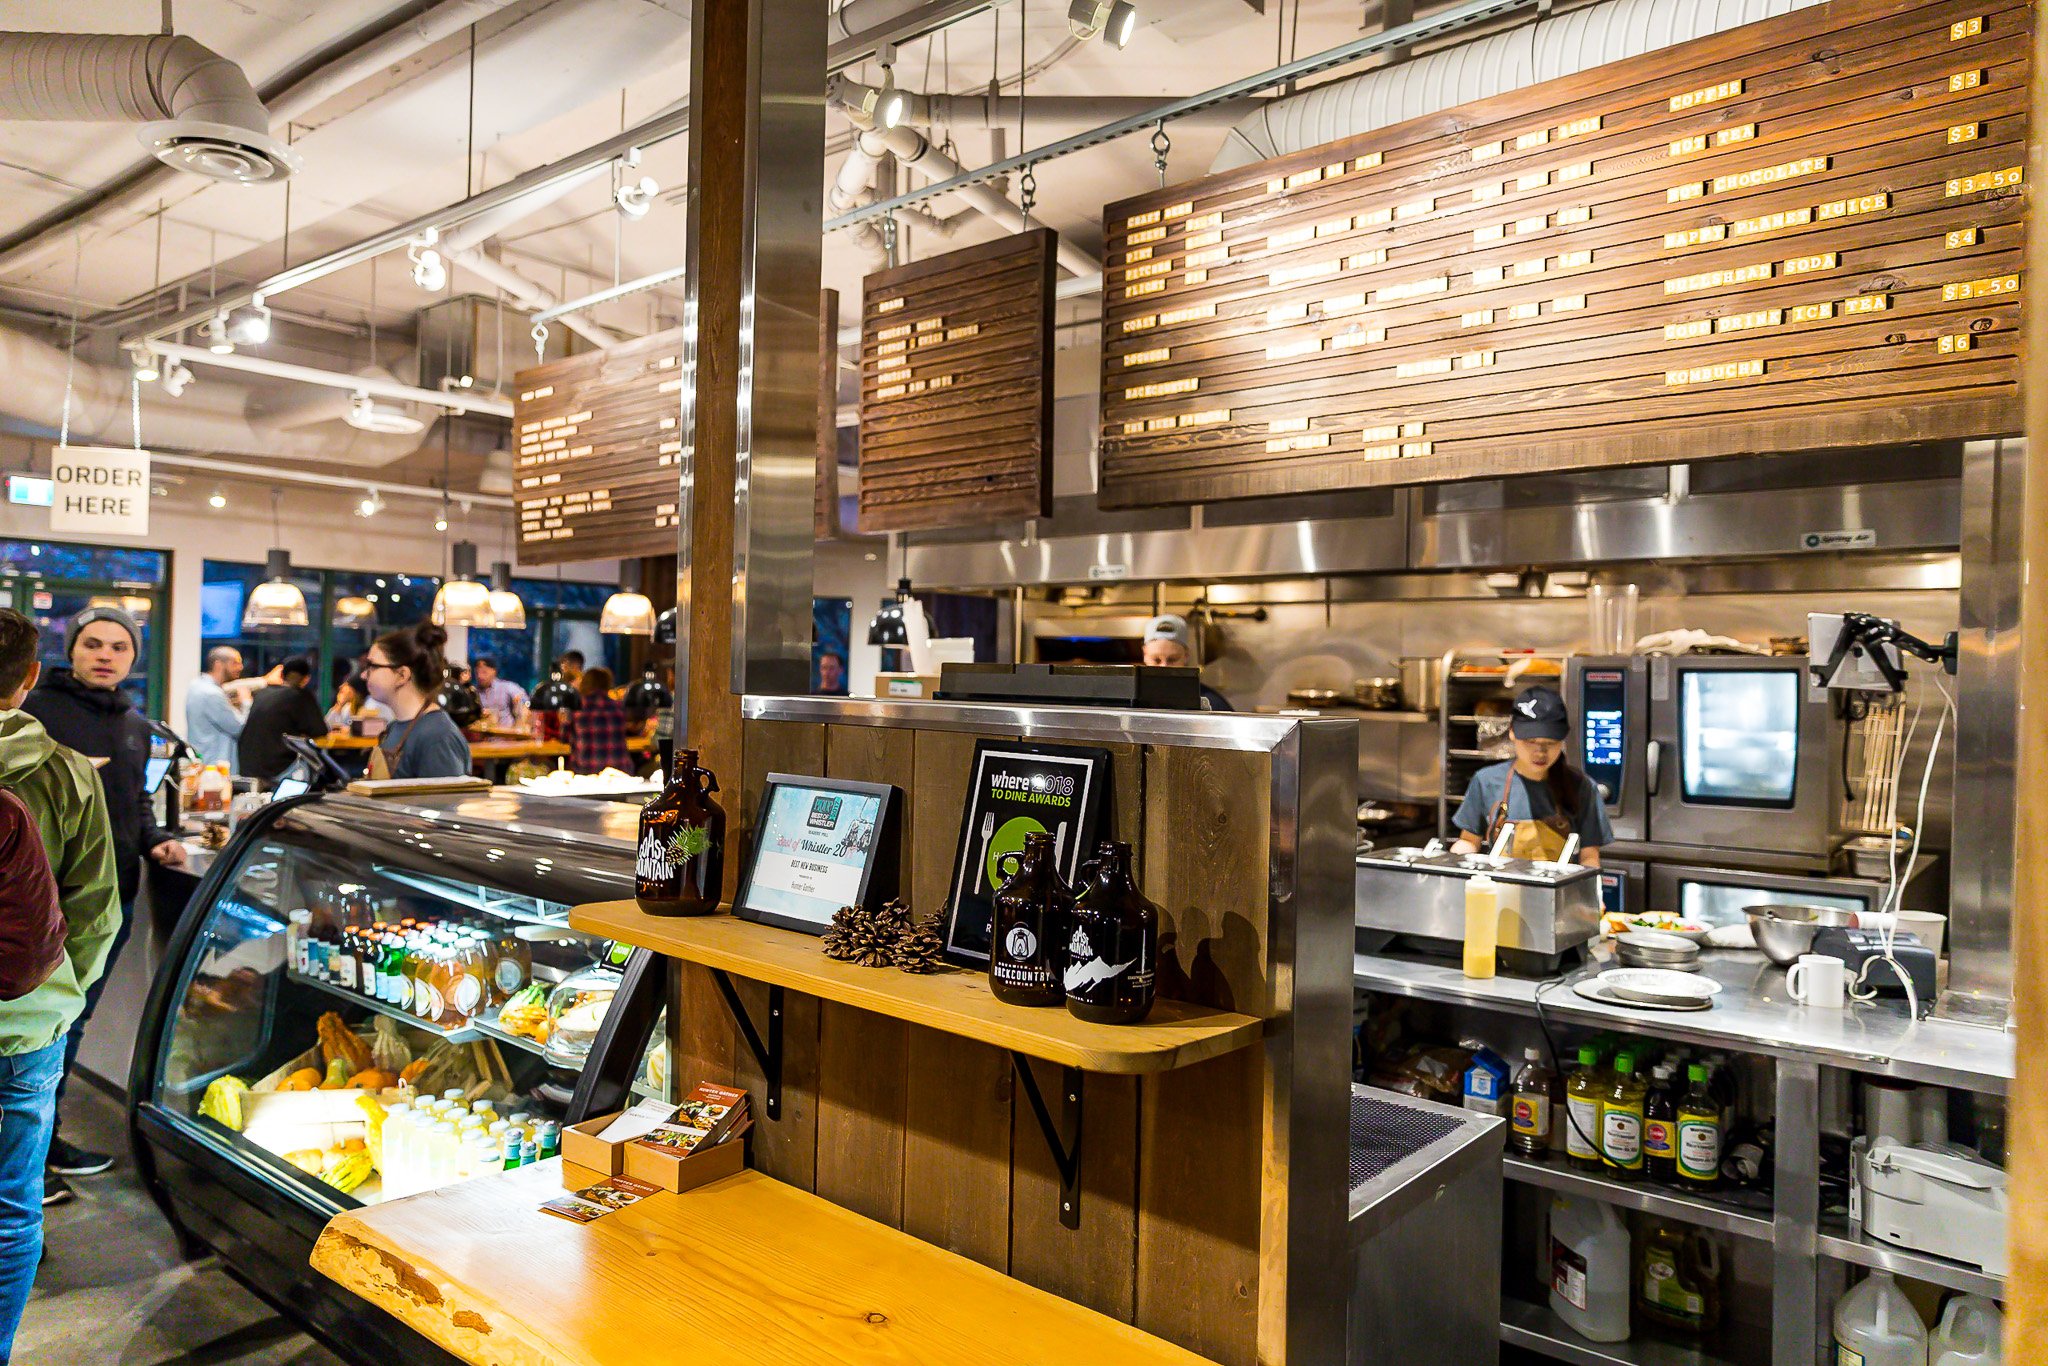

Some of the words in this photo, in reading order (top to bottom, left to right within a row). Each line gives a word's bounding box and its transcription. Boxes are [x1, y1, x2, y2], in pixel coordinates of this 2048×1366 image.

[1952, 19, 1980, 40] $3
[1951, 72, 1978, 91] $3
[1670, 80, 1741, 111] COFFEE
[1670, 136, 1705, 157] HOT
[1717, 124, 1754, 145] TEA
[1950, 125, 1976, 143] $3
[1714, 157, 1826, 193] CHOCOLATE
[1946, 170, 2021, 197] $3.50
[1127, 210, 1161, 229] CRAFT
[1664, 225, 1725, 249] HAPPY
[1735, 208, 1811, 236] PLANET
[1819, 194, 1887, 220] JUICE
[1947, 230, 1975, 249] $4
[1126, 247, 1152, 264] PINT
[1664, 263, 1771, 295] BULLSHEAD
[1784, 252, 1836, 275] SODA
[1943, 277, 2018, 301] $3.50
[1664, 319, 1711, 340] GOOD
[1719, 309, 1781, 333] DRINK
[1792, 302, 1832, 323] ICE
[1845, 294, 1886, 314] TEA
[1939, 336, 1968, 353] $6
[1666, 360, 1763, 386] KOMBUCHA
[57, 465, 142, 486] ORDER
[66, 496, 131, 516] HERE
[991, 770, 1030, 790] where
[1031, 774, 1075, 796] 2018
[991, 788, 1004, 799] TO
[1004, 790, 1027, 802] DINE
[1028, 793, 1071, 807] AWARDS
[638, 827, 667, 861] COAST
[801, 839, 832, 855] Whistler
[791, 860, 801, 868] BEST
